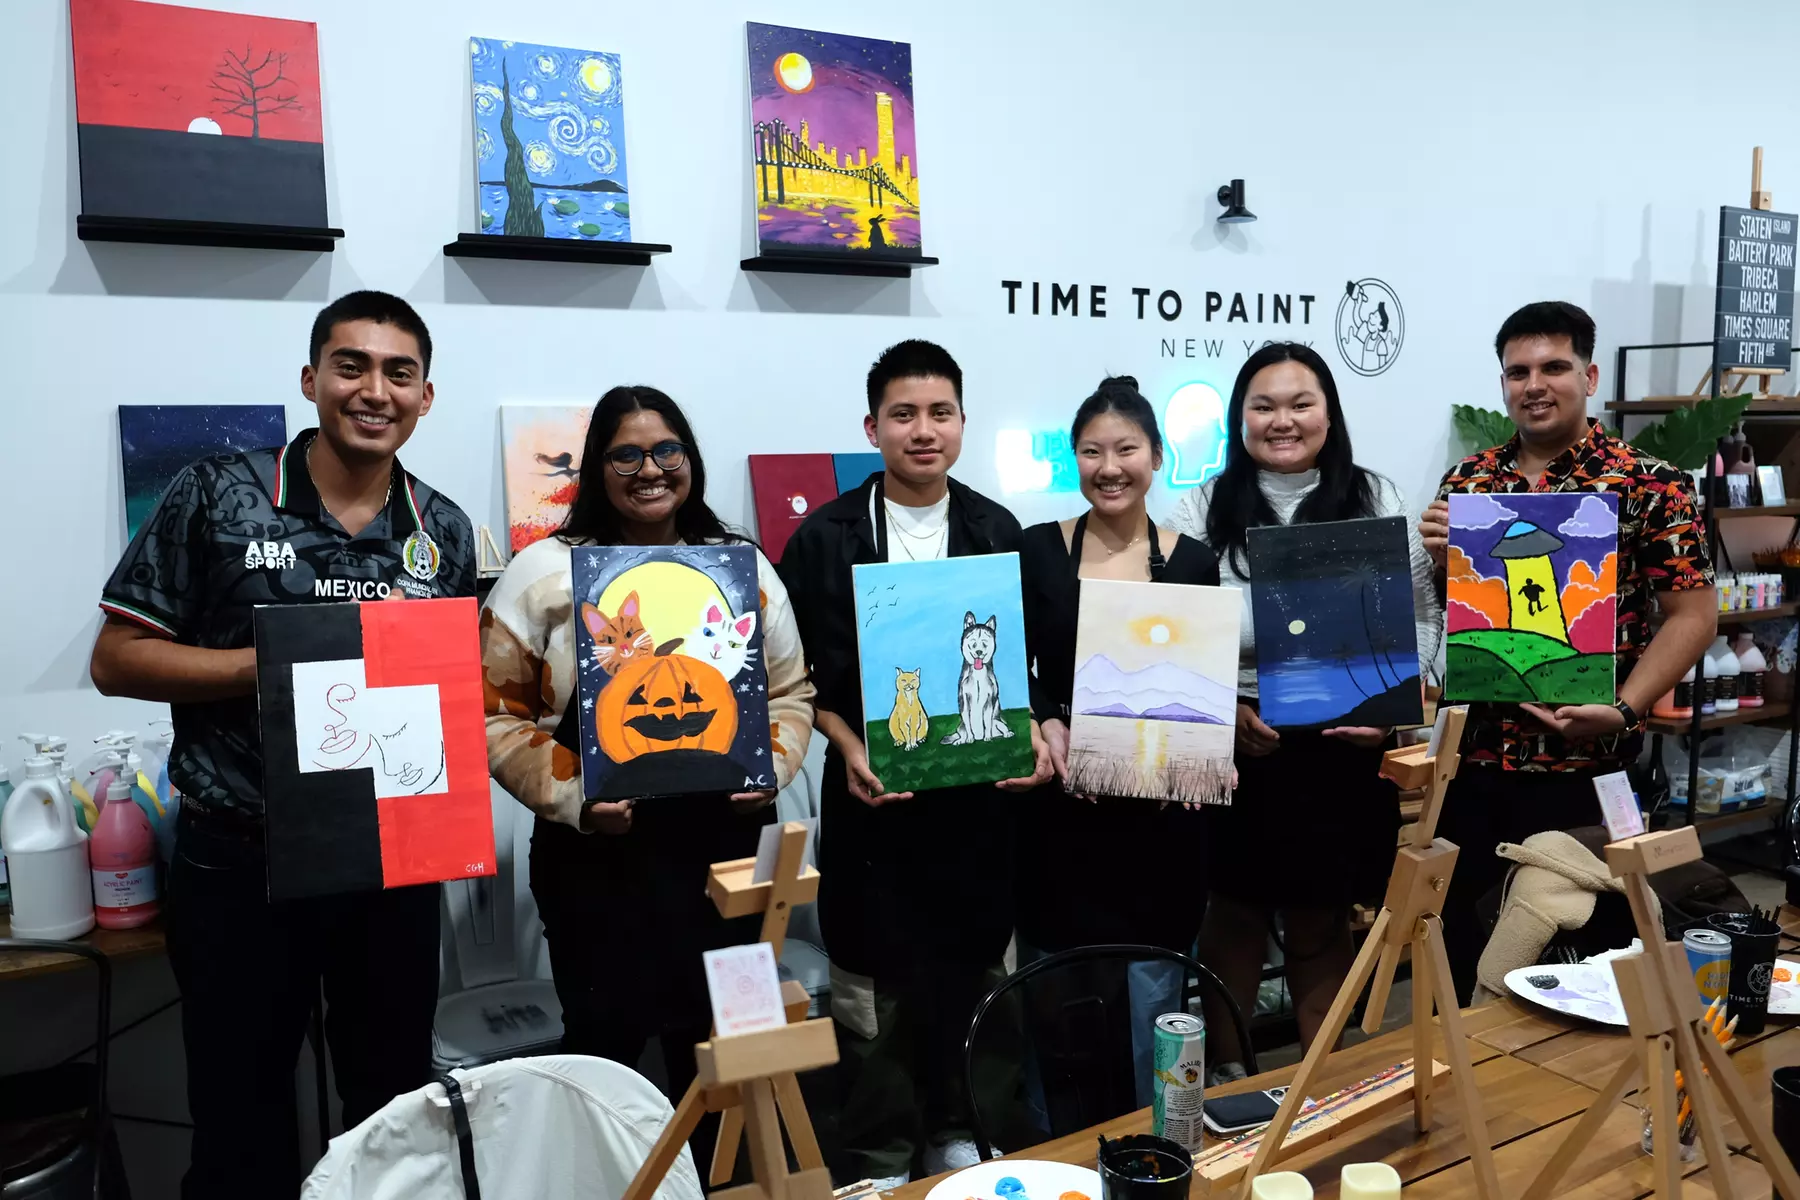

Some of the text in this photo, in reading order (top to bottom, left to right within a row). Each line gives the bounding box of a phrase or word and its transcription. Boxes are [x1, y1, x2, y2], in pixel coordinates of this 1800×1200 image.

[1739, 215, 1791, 240] STATEN ISLAND
[1728, 239, 1794, 267] BATTERY PARK
[1741, 266, 1779, 290] TRIBECA
[1001, 280, 1315, 325] TIME TO PAINT
[1739, 290, 1777, 315] HARLEM
[1724, 315, 1791, 340] TIMES SQUARE
[1161, 338, 1224, 358] NEW
[1739, 341, 1765, 364] FIFTH
[245, 541, 297, 558] ABA
[244, 557, 297, 570] SPORT
[314, 579, 391, 599] MEXICO
[465, 862, 484, 873] CGH
[1729, 993, 1752, 1003] TIME
